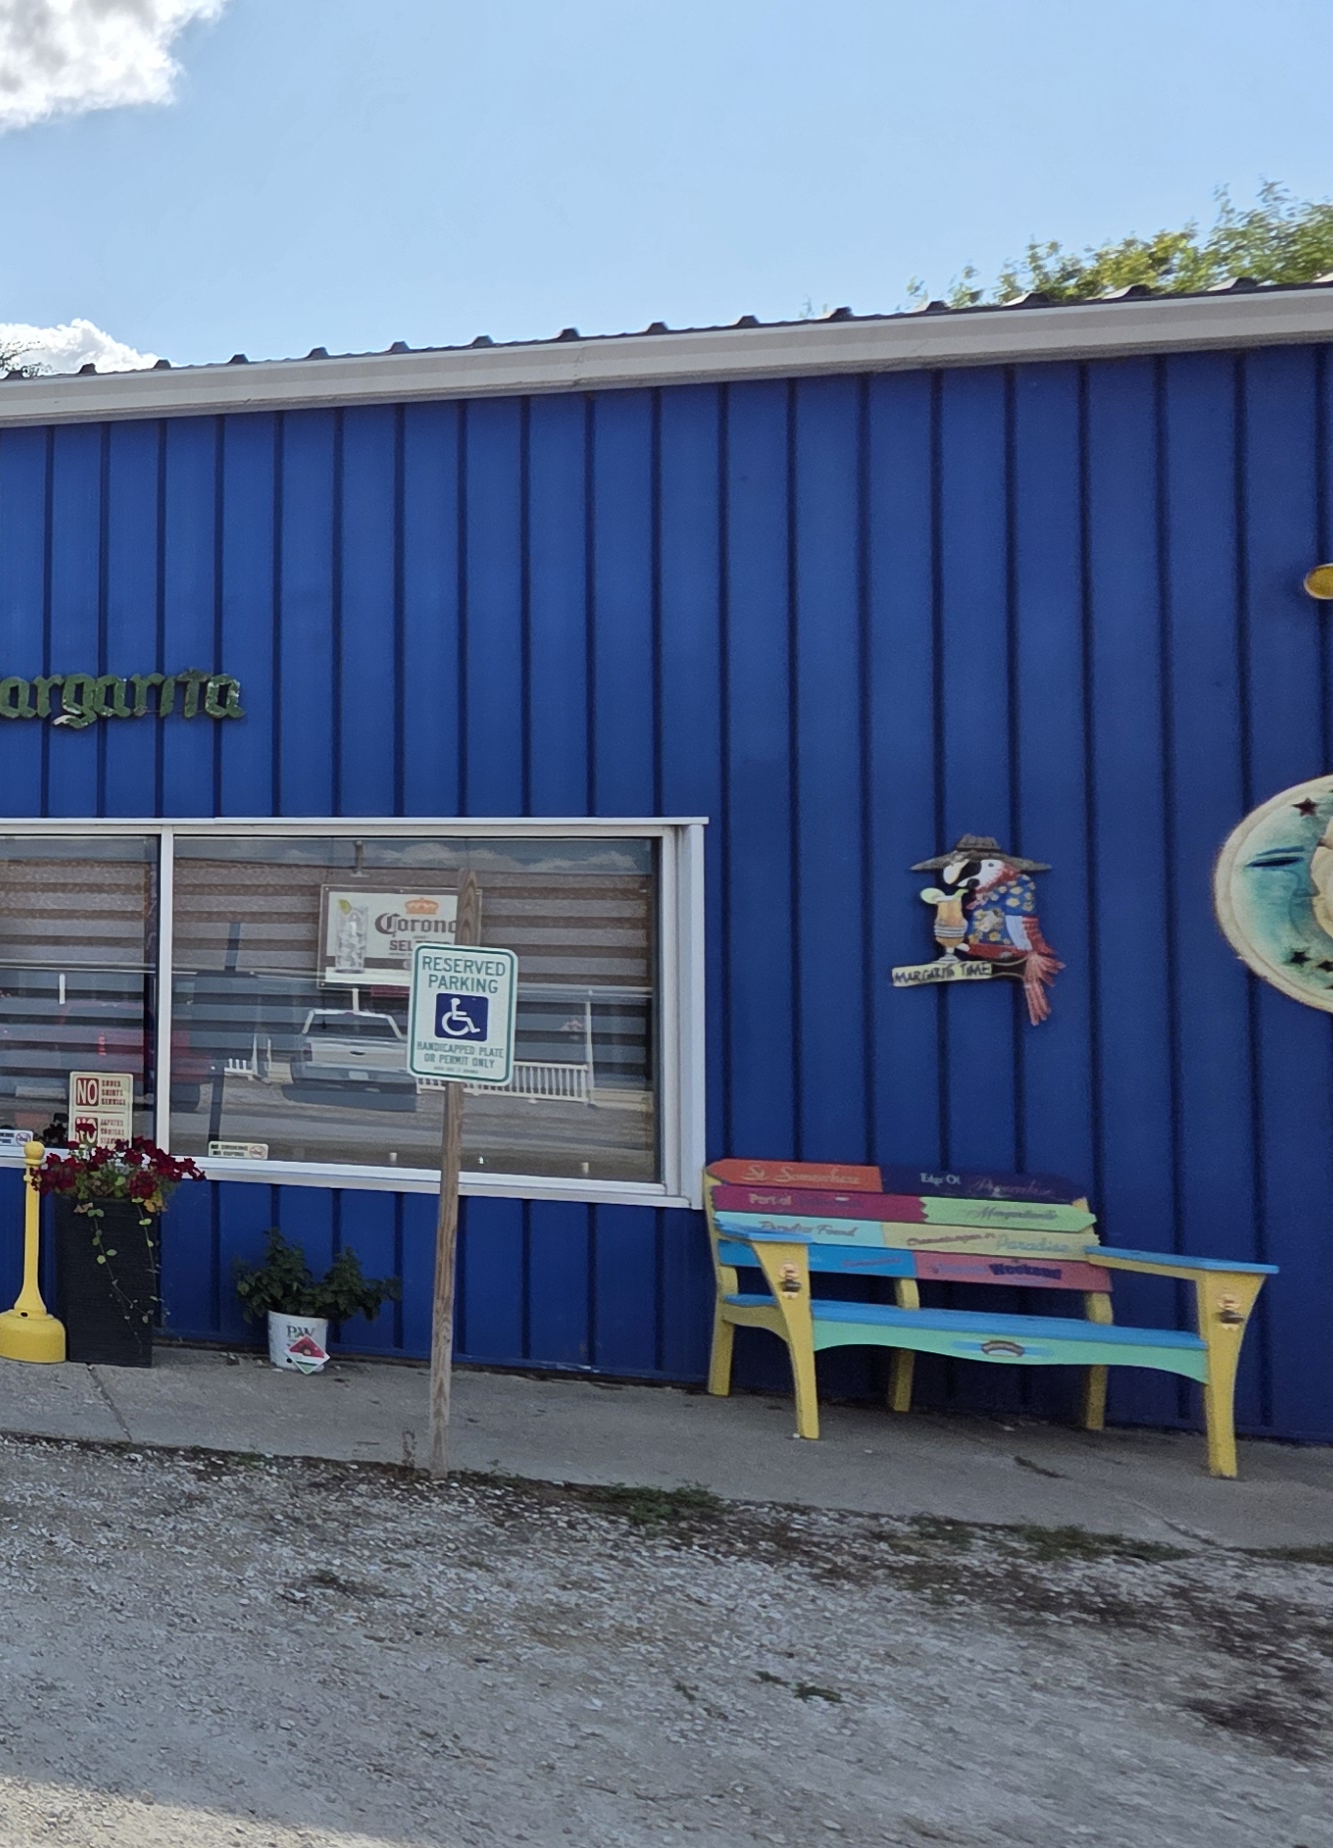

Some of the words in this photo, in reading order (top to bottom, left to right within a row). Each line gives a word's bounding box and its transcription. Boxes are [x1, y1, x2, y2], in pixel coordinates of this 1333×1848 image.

[422, 956, 506, 976] RESERVED
[960, 962, 991, 976] TIME
[428, 974, 498, 994] PARKING
[416, 1041, 475, 1055] HANDICAPPED
[479, 1046, 504, 1059] PLATE
[424, 1053, 436, 1062] OR
[439, 1054, 469, 1066] PERMIT
[472, 1057, 496, 1069] ONLY
[77, 1079, 98, 1105] NO
